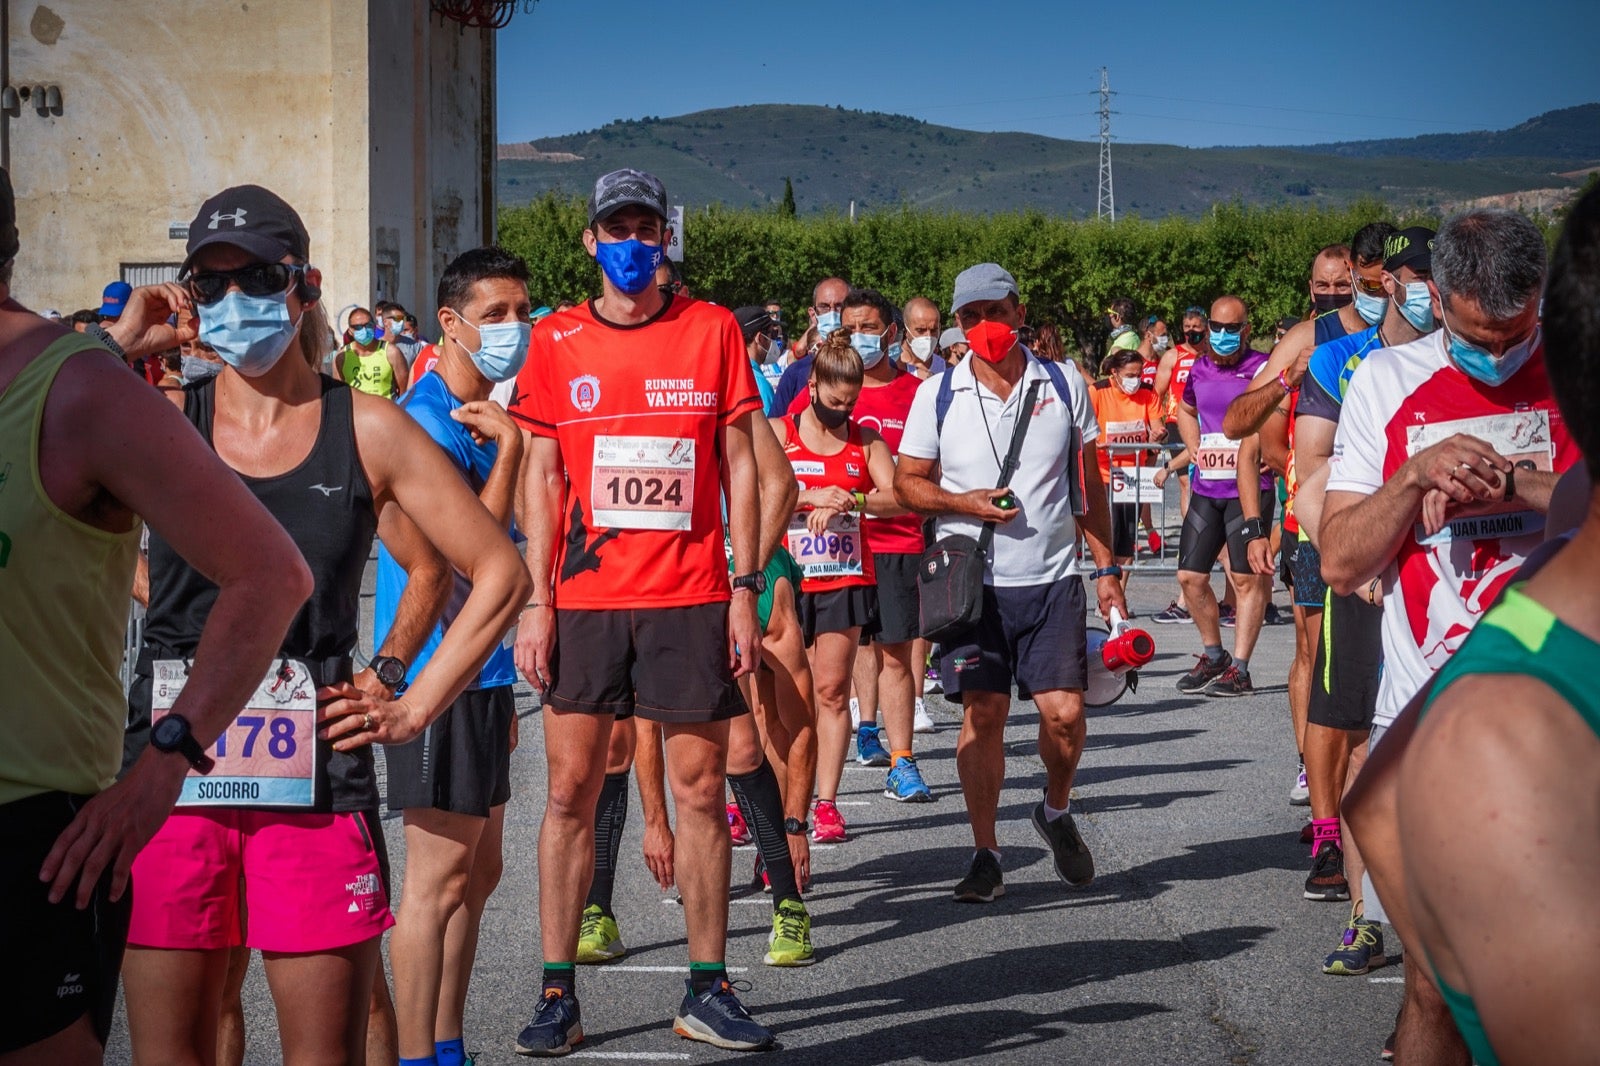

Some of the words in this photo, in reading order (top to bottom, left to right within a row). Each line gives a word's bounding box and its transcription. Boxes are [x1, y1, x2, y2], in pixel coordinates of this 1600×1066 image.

[645, 379, 694, 391] RUNNING
[645, 391, 718, 408] VAMPIROS
[1202, 453, 1235, 468] 1014
[606, 476, 683, 507] 1024
[1481, 515, 1523, 534] RAMÓN
[800, 534, 854, 557] 2096
[809, 564, 822, 574] ANA
[198, 781, 260, 800] SOCORRO
[355, 873, 370, 883] THE
[345, 880, 371, 892] NORTH
[353, 887, 374, 897] FACE
[57, 984, 84, 999] ipso
